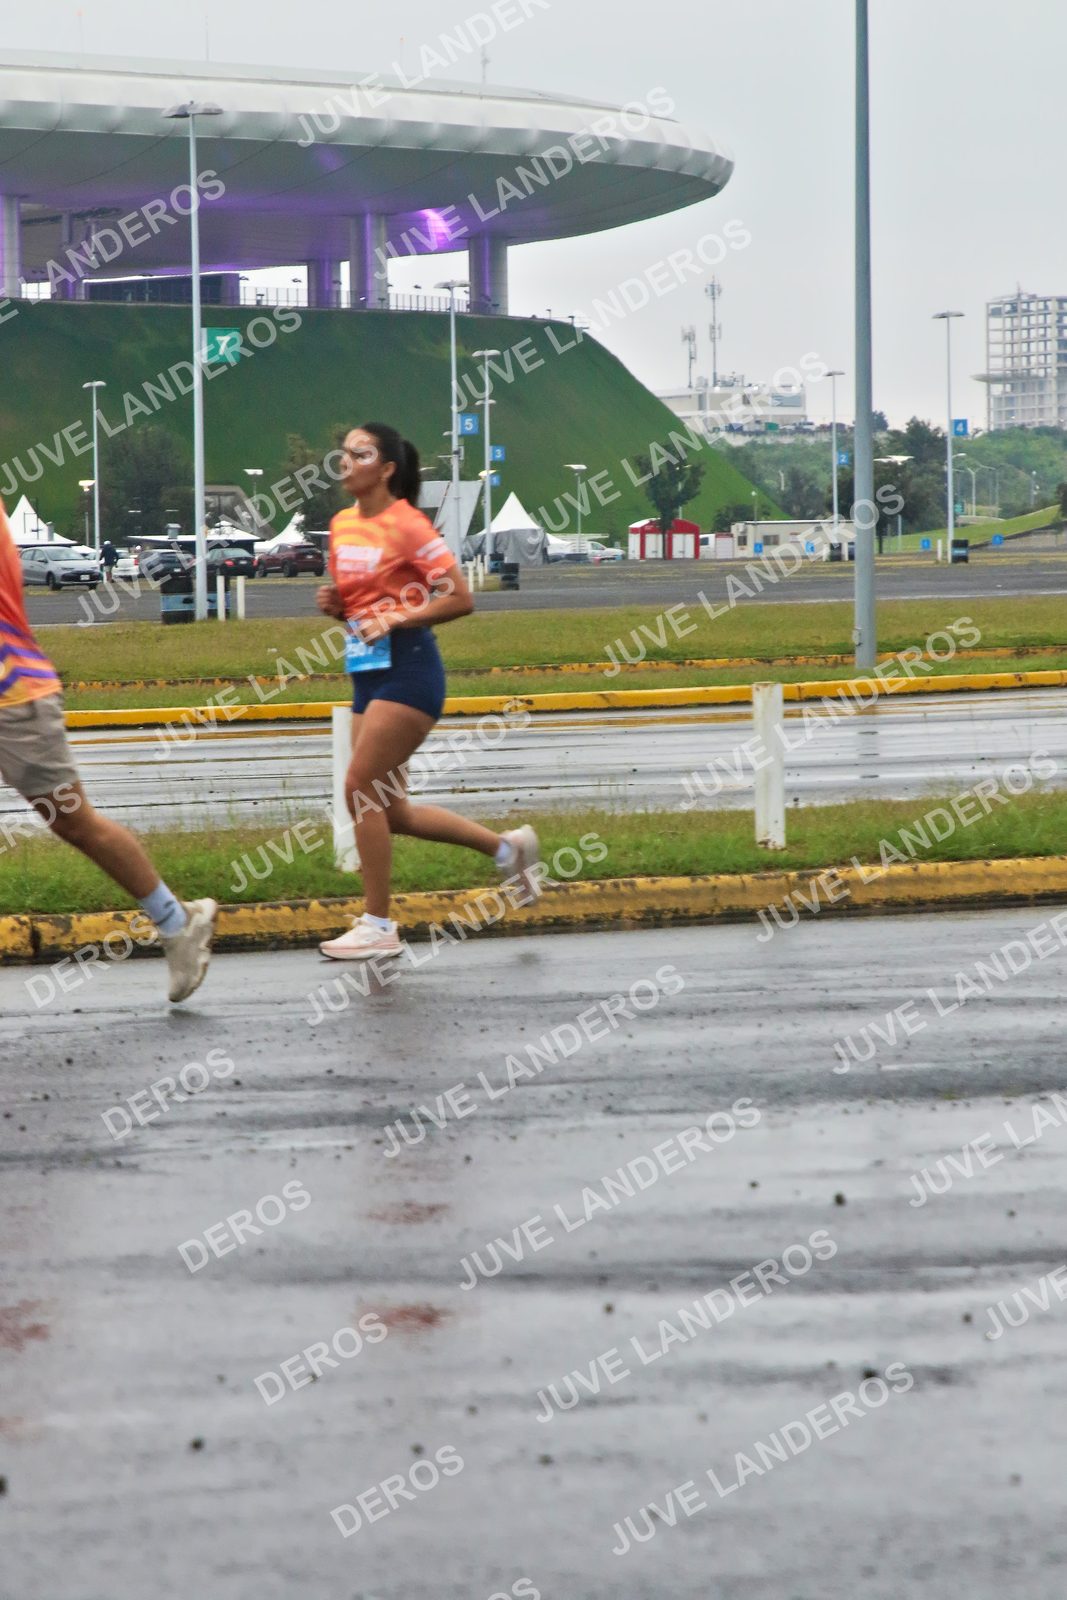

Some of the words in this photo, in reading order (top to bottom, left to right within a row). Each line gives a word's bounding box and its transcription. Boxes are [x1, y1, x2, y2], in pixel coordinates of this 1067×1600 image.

[216, 335, 231, 355] 7
[464, 418, 473, 431] 5
[956, 421, 963, 432] 4
[495, 449, 502, 458] 3
[841, 453, 848, 463] 2
